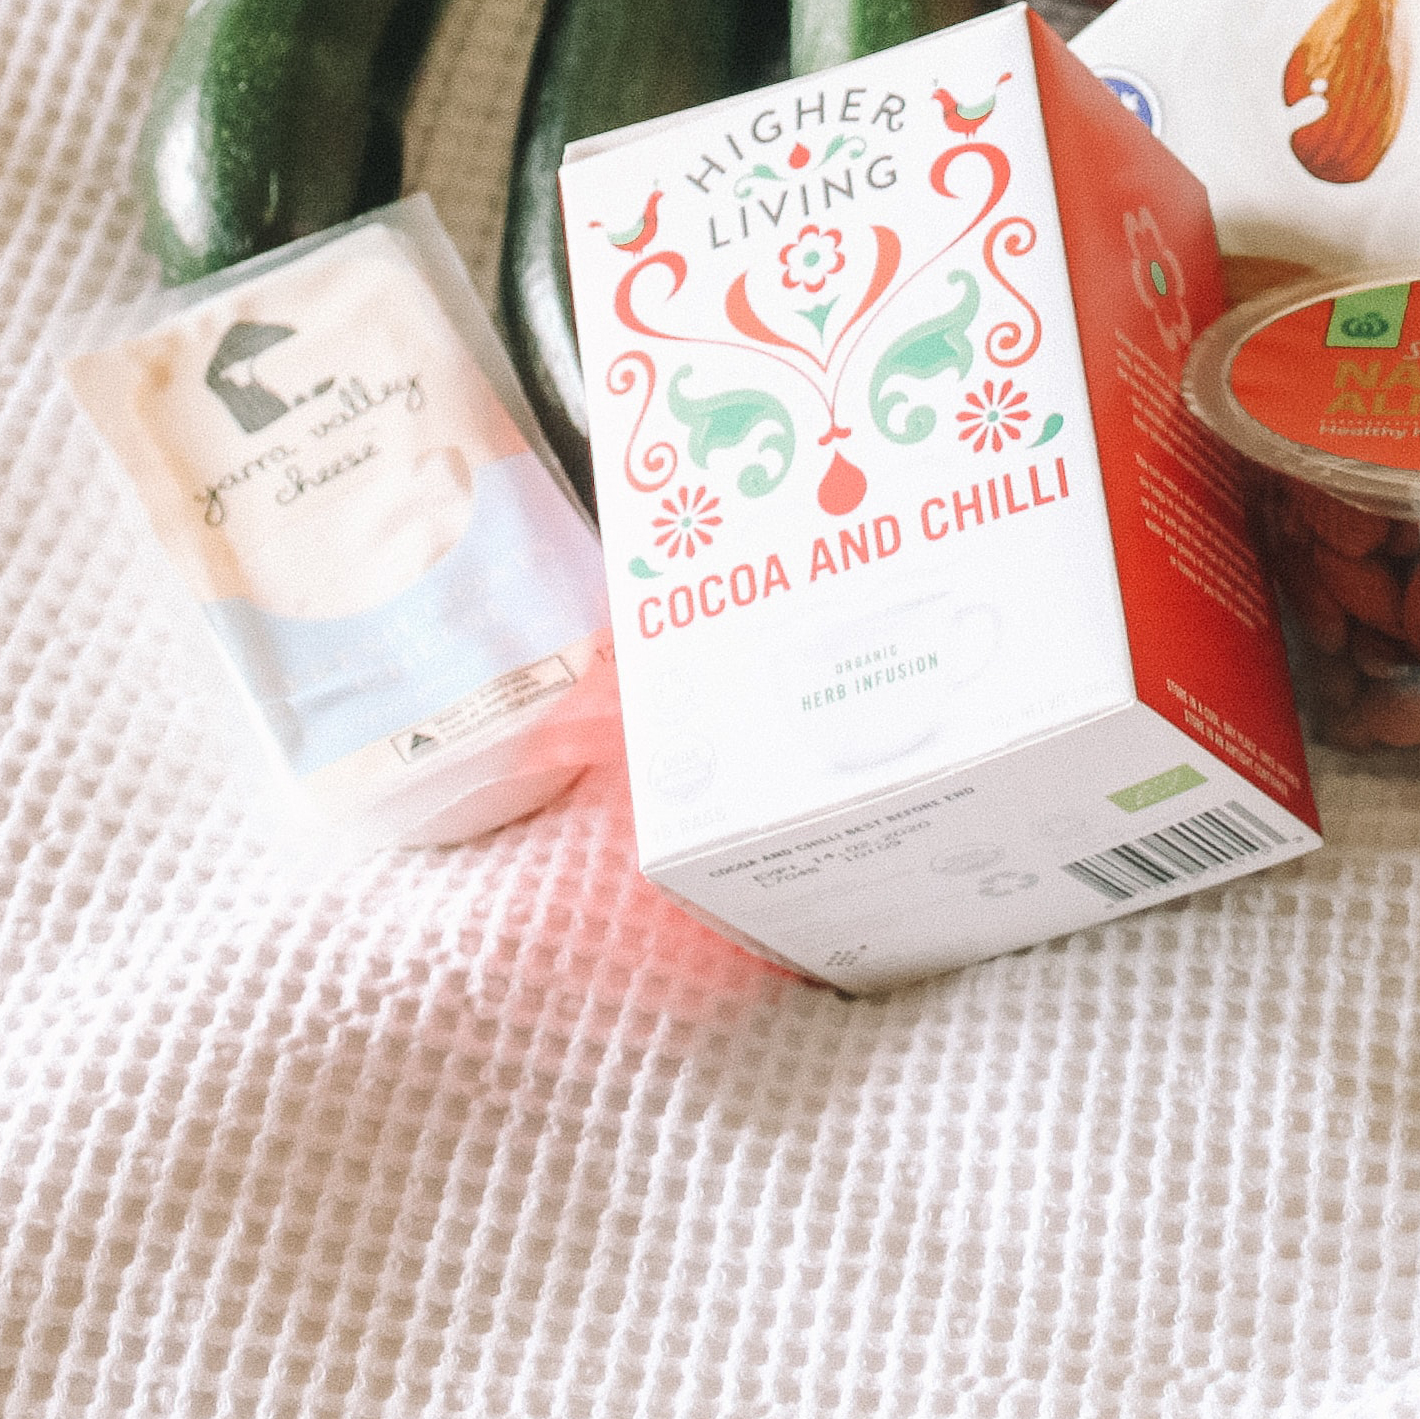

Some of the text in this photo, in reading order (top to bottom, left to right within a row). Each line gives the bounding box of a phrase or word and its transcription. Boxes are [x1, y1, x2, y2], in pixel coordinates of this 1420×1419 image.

[686, 86, 906, 194] HIGHER
[707, 154, 899, 250] LIVING
[310, 371, 426, 441] valley
[193, 442, 291, 528] yarra
[274, 439, 382, 506] cheese
[638, 456, 1070, 640] COCOA AND CHILLI
[801, 652, 940, 712] HERB INFUSION
[835, 644, 898, 675] ORGANIC
